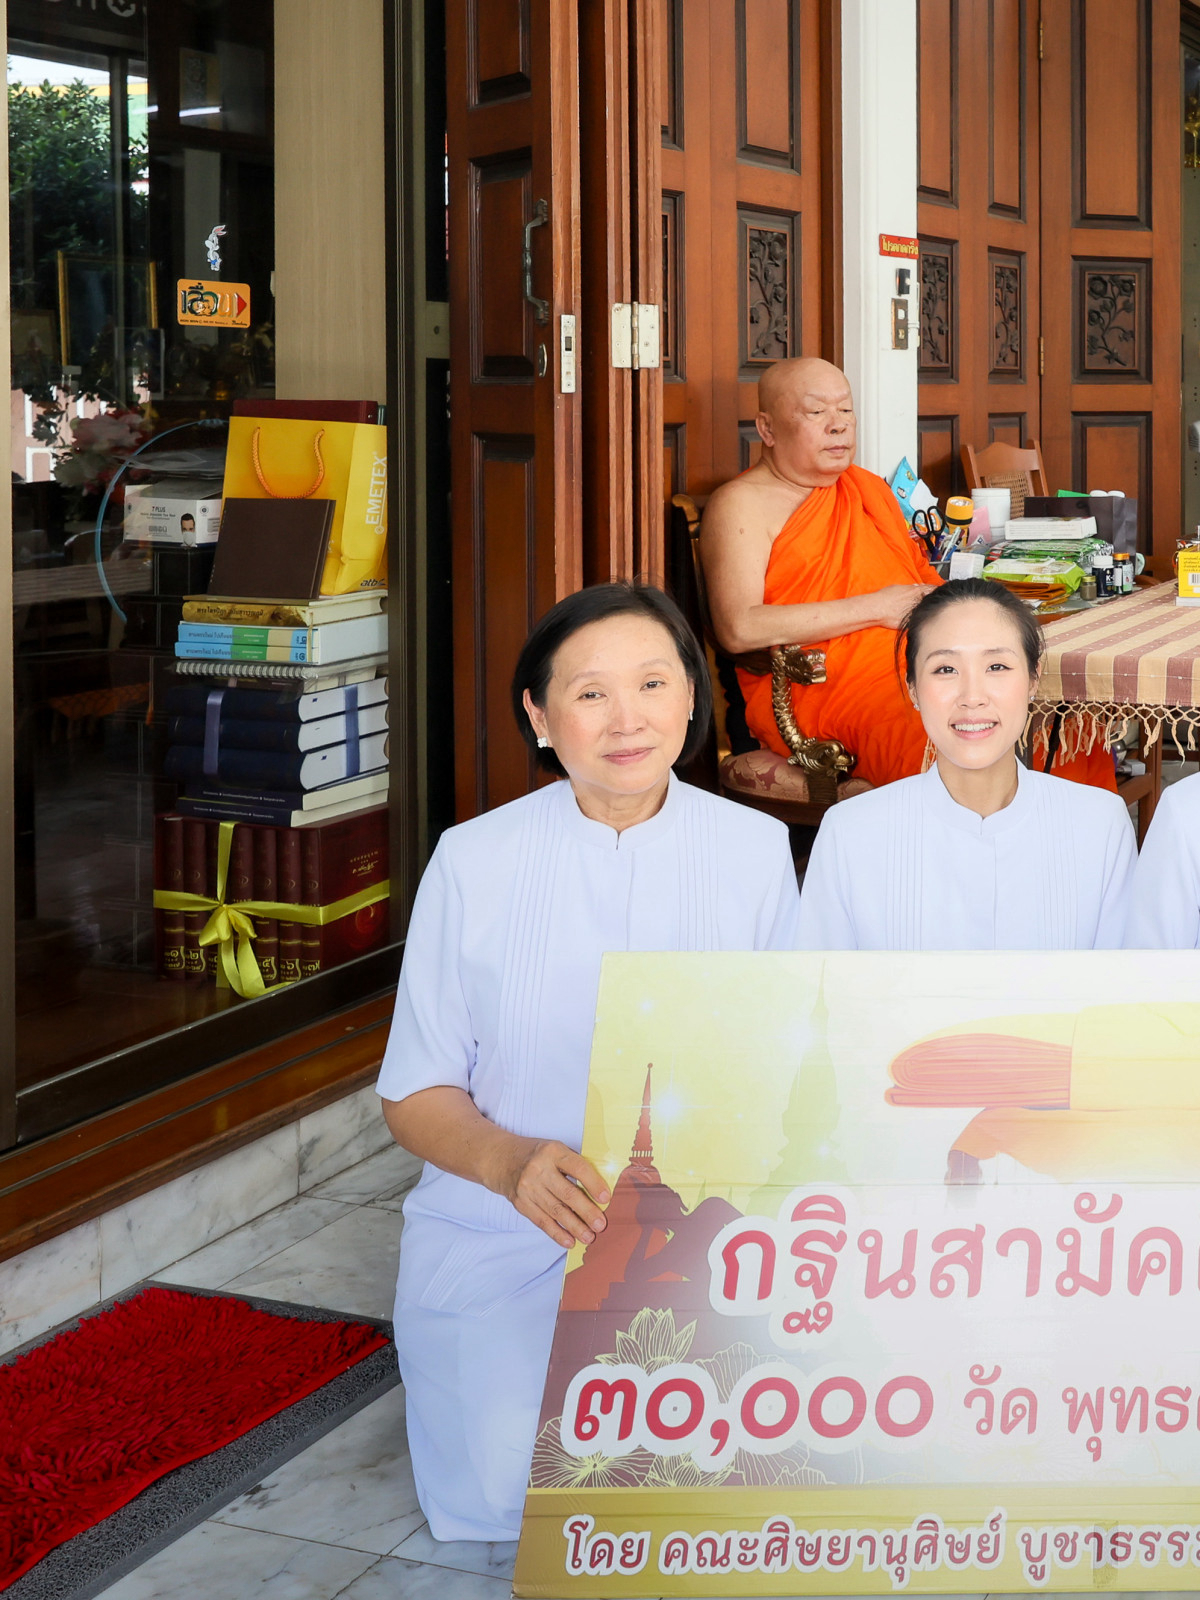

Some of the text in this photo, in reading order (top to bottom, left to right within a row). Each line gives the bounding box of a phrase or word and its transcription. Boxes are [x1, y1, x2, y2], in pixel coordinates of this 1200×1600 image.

[365, 456, 388, 525] EMETEX
[574, 1375, 935, 1458] ๓๐,๐๐๐
[963, 1363, 1038, 1436] วัด
[568, 1520, 646, 1570] โดย
[662, 1512, 1003, 1583] คณะศิษยานุศิษย์
